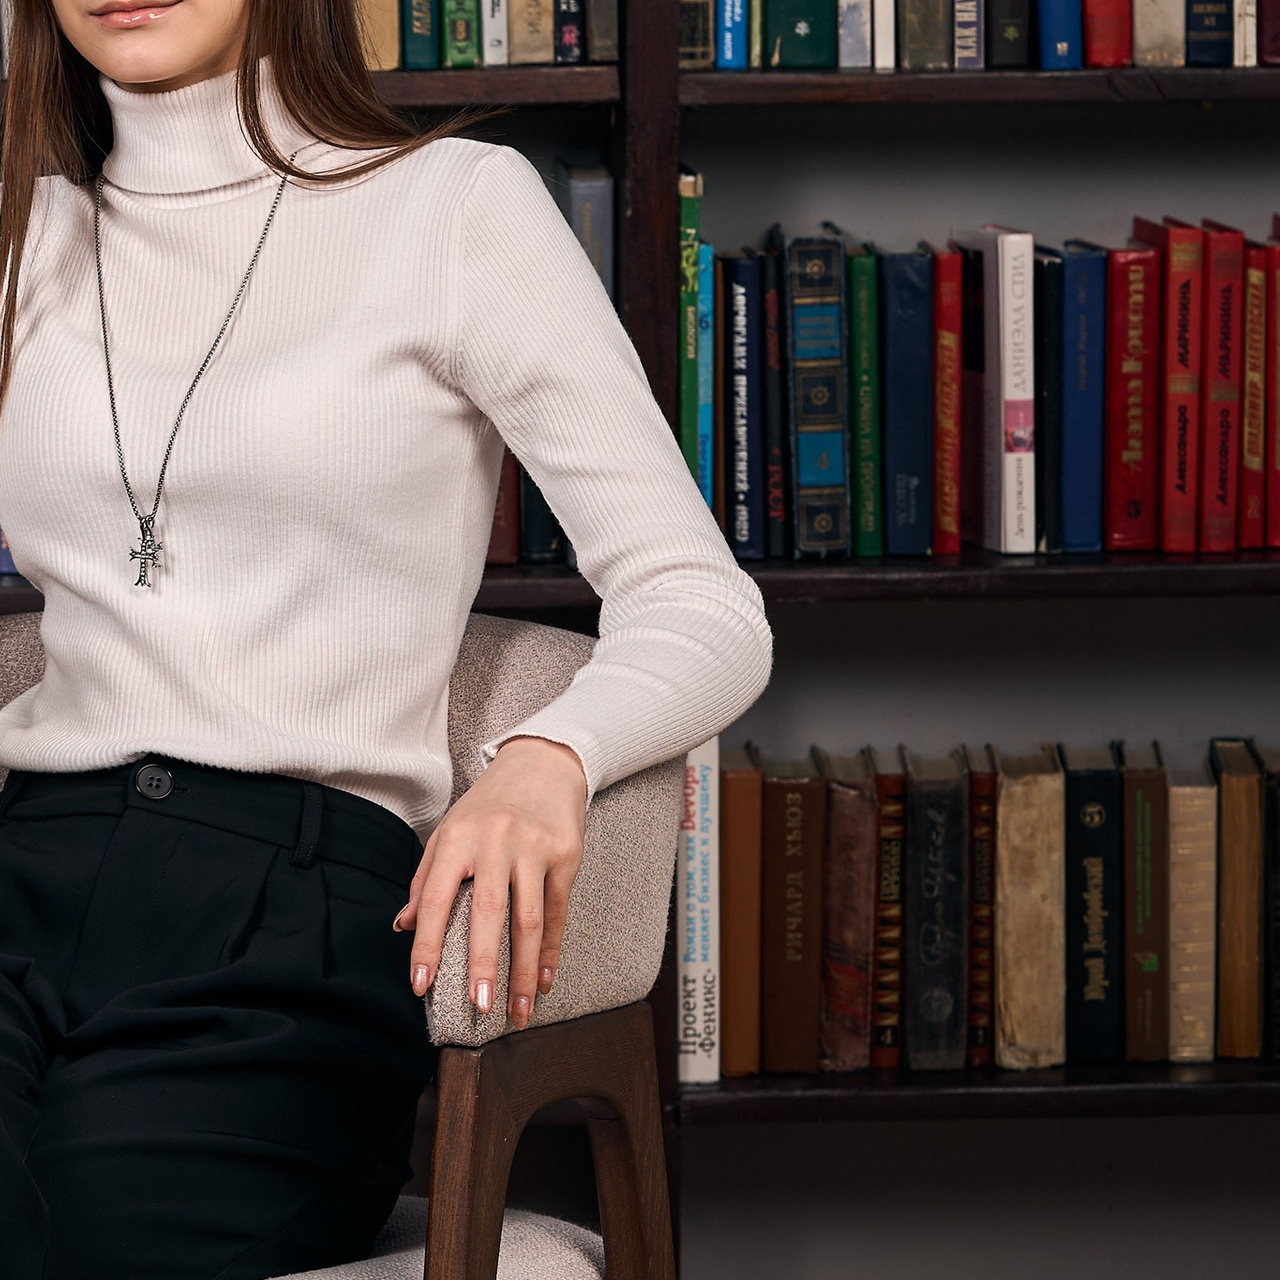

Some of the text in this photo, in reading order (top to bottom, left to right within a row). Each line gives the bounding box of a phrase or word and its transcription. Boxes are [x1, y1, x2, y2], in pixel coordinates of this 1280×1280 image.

[954, 27, 978, 58] КАК
[1011, 253, 1026, 392] ДАНИЭЛА СТИЛ
[1121, 265, 1146, 472] Агата Кристи
[680, 766, 700, 831] DevOps
[697, 764, 713, 833] лучшему
[696, 851, 710, 904] бизнес
[787, 792, 804, 961] РИЧАРД ХЬЮЗ
[684, 915, 697, 963] Роман
[698, 908, 710, 962] меняет
[679, 975, 700, 1055] Проект
